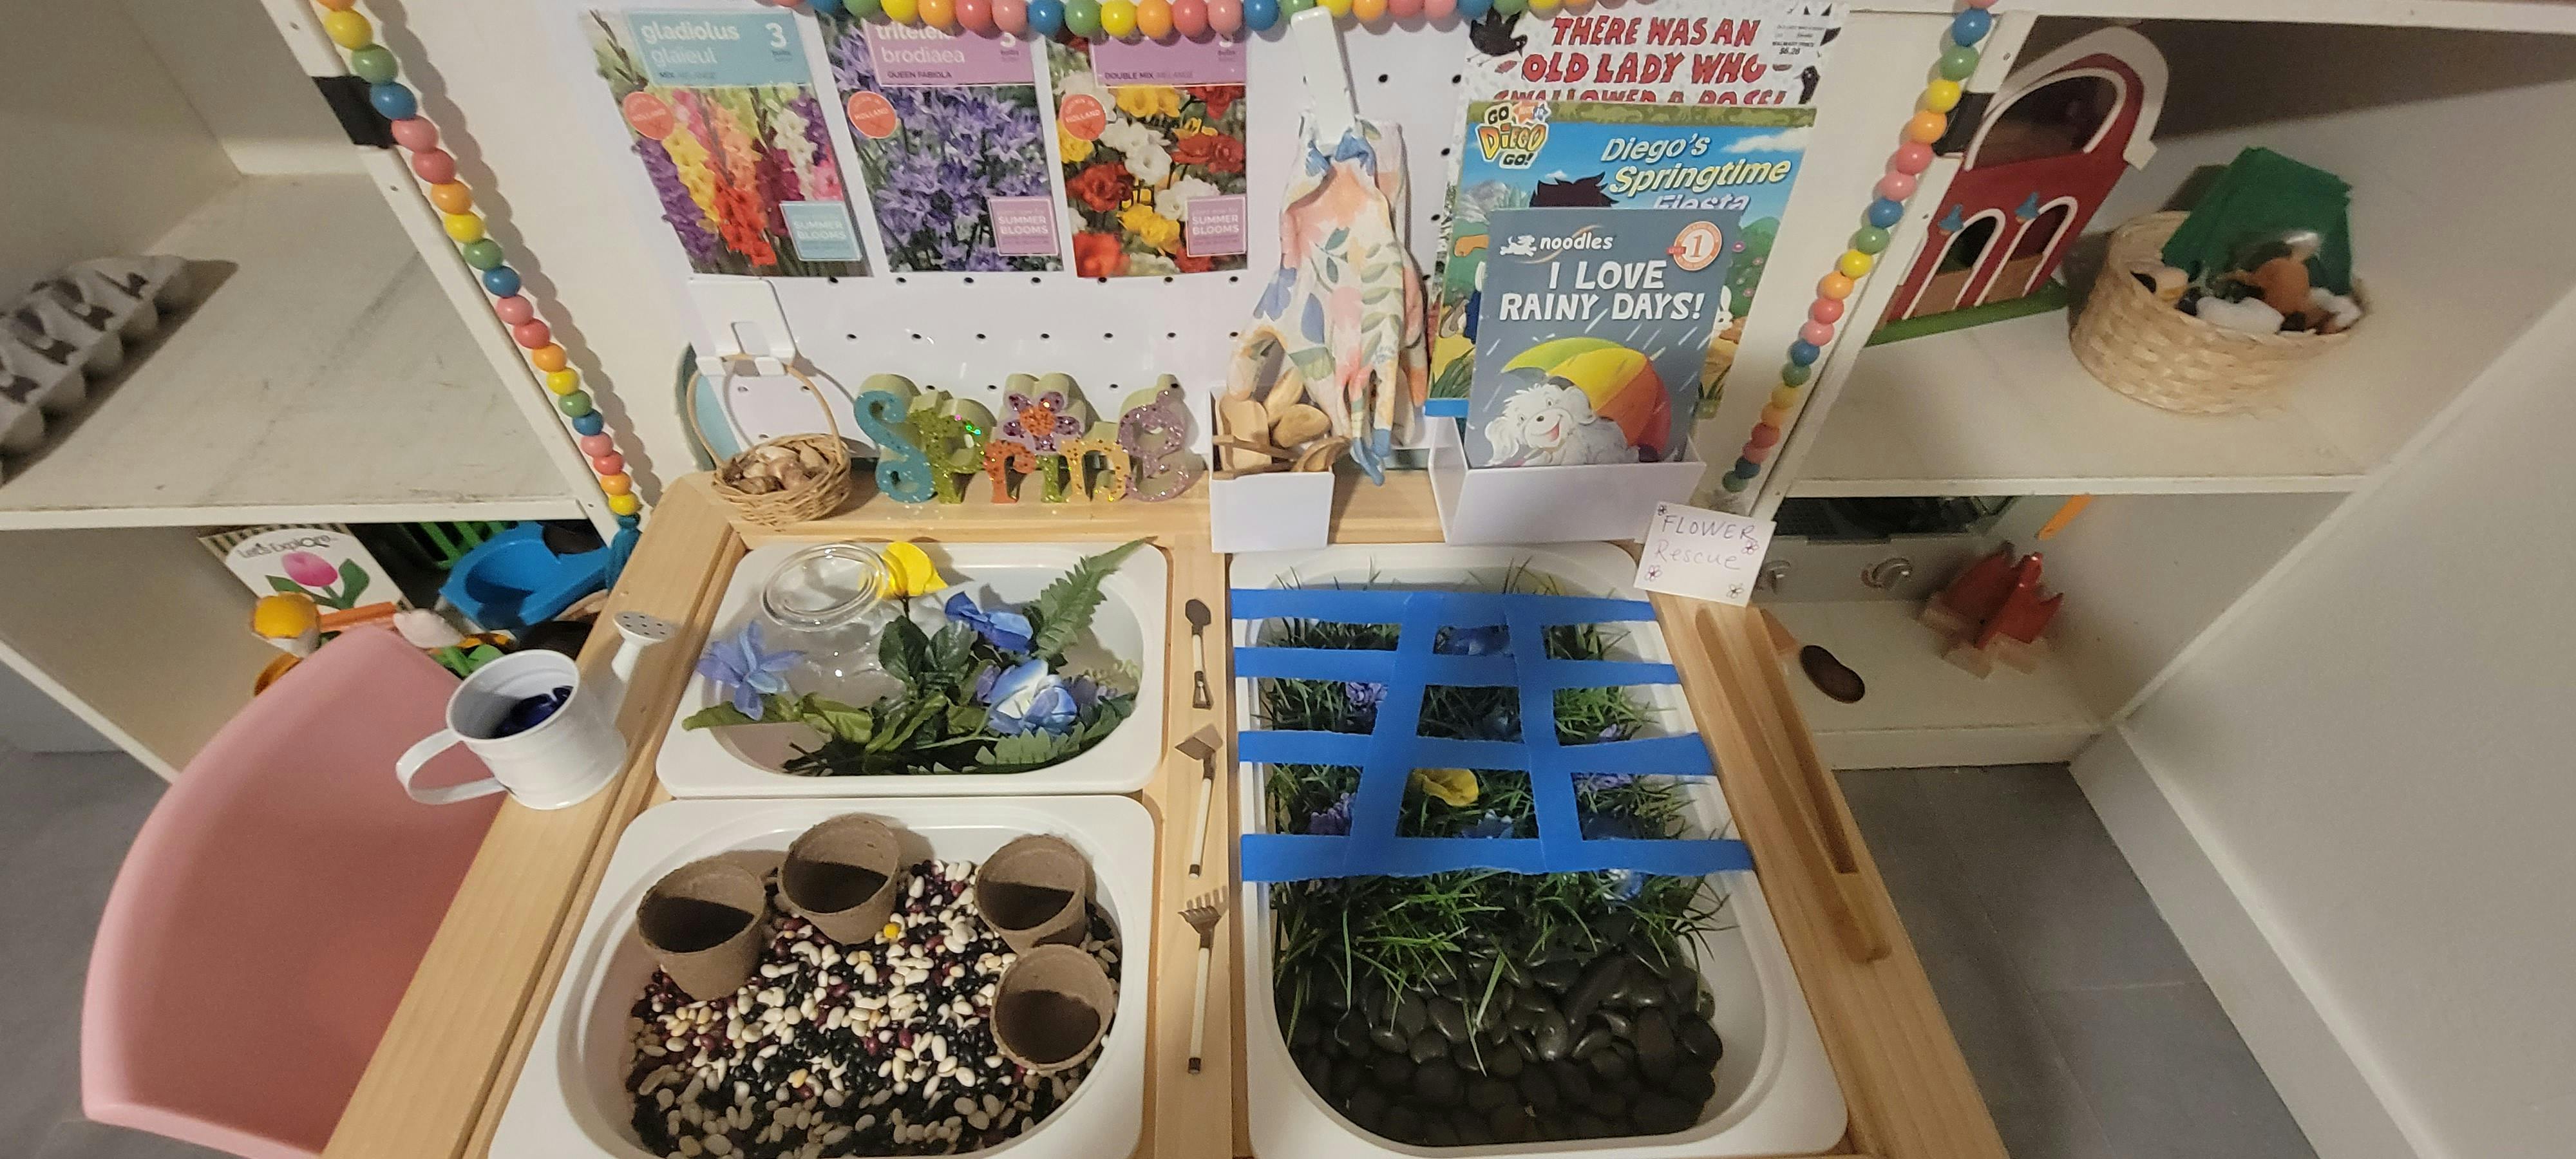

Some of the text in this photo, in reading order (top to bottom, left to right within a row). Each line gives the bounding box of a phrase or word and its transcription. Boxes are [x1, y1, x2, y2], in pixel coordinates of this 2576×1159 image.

[641, 21, 740, 44] gladiolus
[765, 23, 787, 48] 3
[1552, 15, 1761, 46] THERE WAS AN
[880, 47, 965, 63] brodiaea
[1522, 52, 1767, 84] OLD LADY WHO
[1065, 109, 1101, 123] HOLLAND
[1488, 106, 1510, 124] GO
[1502, 153, 1534, 165] GO!
[1600, 133, 1710, 164] Diego's
[1610, 158, 1792, 197] Springtime
[998, 216, 1046, 225] SUMMER
[999, 226, 1048, 234] BLOOMS
[1192, 214, 1239, 225] SUMMER
[1193, 224, 1240, 235] BLOOMS
[1540, 232, 1613, 250] noodles
[1690, 234, 1703, 258] 1
[1549, 261, 1560, 289] I
[1575, 259, 1667, 290] LOVE
[1499, 292, 1705, 321] RAINY DAYS!
[855, 389, 1185, 504] Spring
[1662, 514, 1756, 542] FLOWER
[1653, 539, 1741, 570] Rescue
